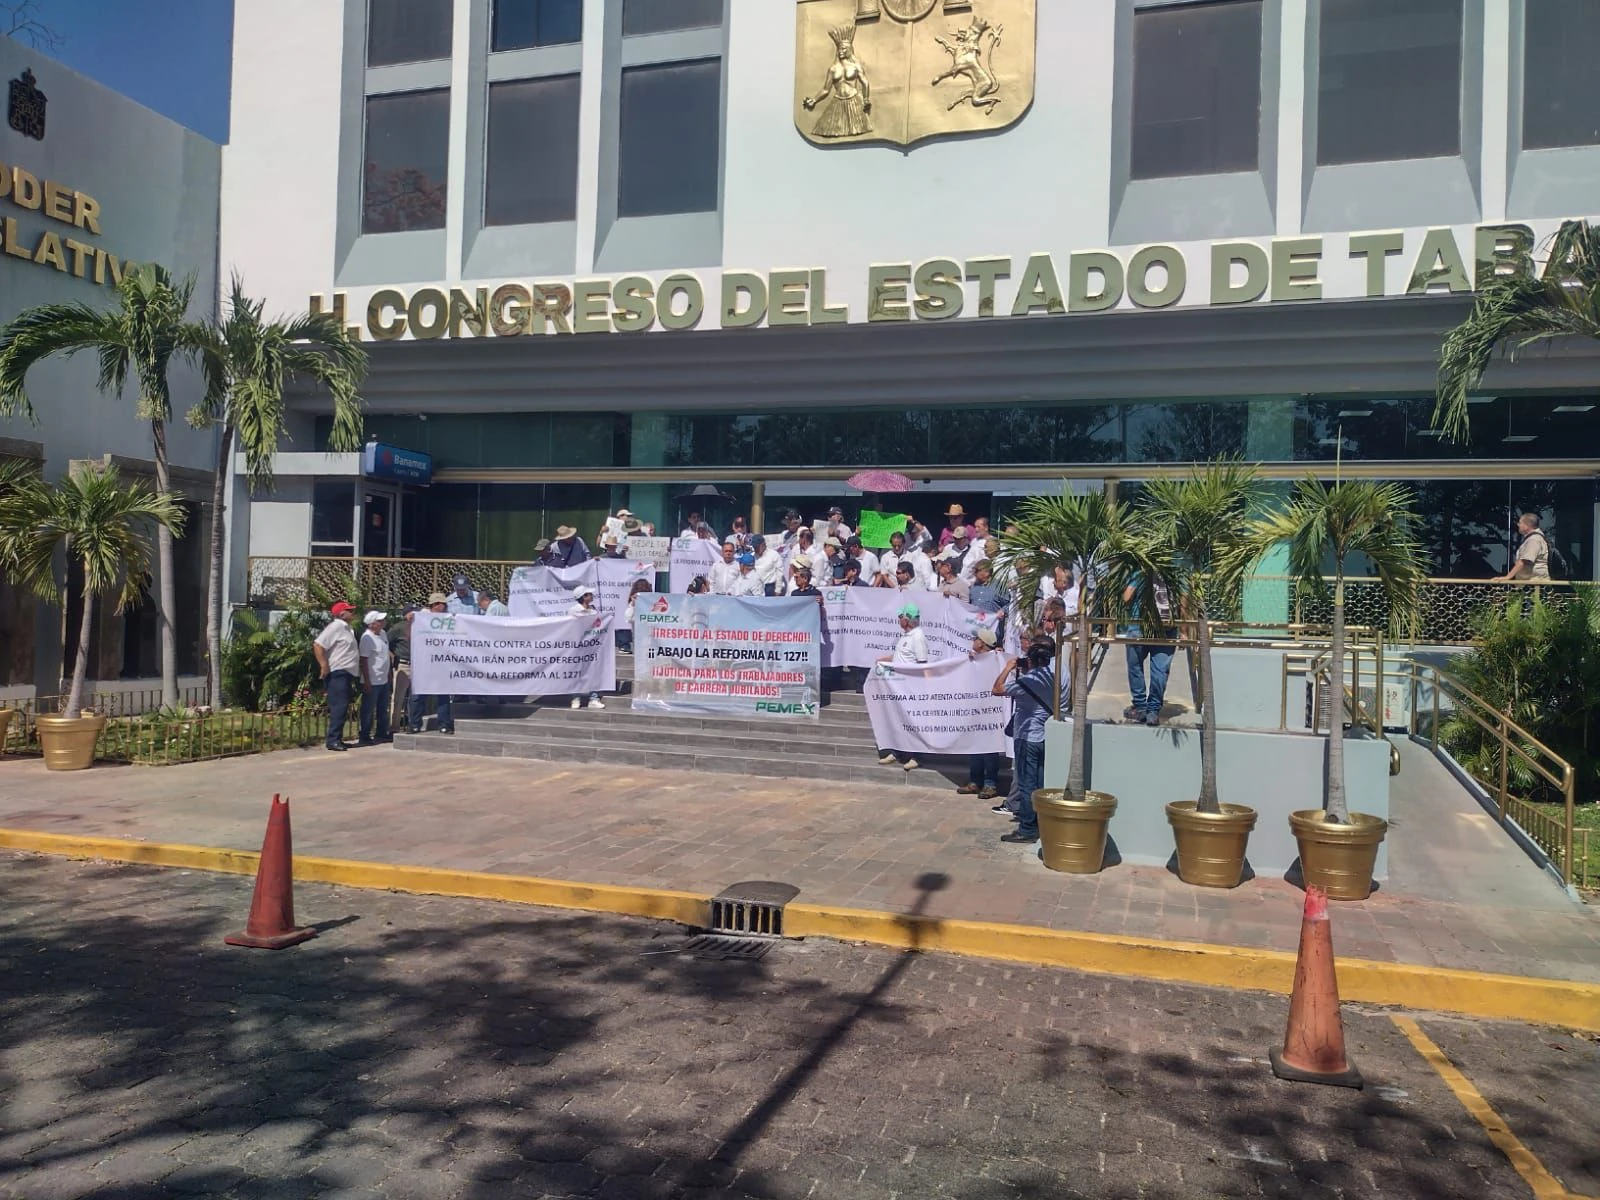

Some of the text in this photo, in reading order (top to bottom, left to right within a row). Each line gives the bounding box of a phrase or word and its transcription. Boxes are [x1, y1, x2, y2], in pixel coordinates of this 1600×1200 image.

[0, 216, 137, 286] LATIV
[367, 273, 703, 341] CONGRESO
[720, 268, 847, 328] DEL
[868, 244, 1187, 322] ESTADO
[1210, 237, 1323, 305] DE
[827, 591, 846, 600] CFE
[430, 617, 456, 630] CFE
[640, 615, 679, 623] PEMEX
[653, 628, 811, 643] ¡¡RESPETO AL ESTADO DE DERECHO!!
[425, 638, 446, 647] HOY
[448, 639, 490, 648] ATENTAN
[493, 640, 532, 649] CONTRA
[535, 641, 551, 649] LOS
[431, 653, 597, 664] ¡MAÑANA IRÁN POR TUS DERECHOS!
[657, 647, 692, 659] ABAJO
[695, 648, 709, 658] LA
[713, 649, 764, 661] REFORMA
[767, 650, 781, 661] AL
[783, 651, 809, 662] 127!!
[449, 670, 582, 680] ¡ABAJO LA REFORMA AL 127!
[694, 668, 717, 679] PARA
[720, 669, 735, 680] LOS
[738, 670, 804, 682] TRABAJADORES
[675, 682, 781, 697] DE CARRERA JUBILADOS!
[930, 693, 953, 701] ATENTA
[756, 702, 815, 714] PEMEX
